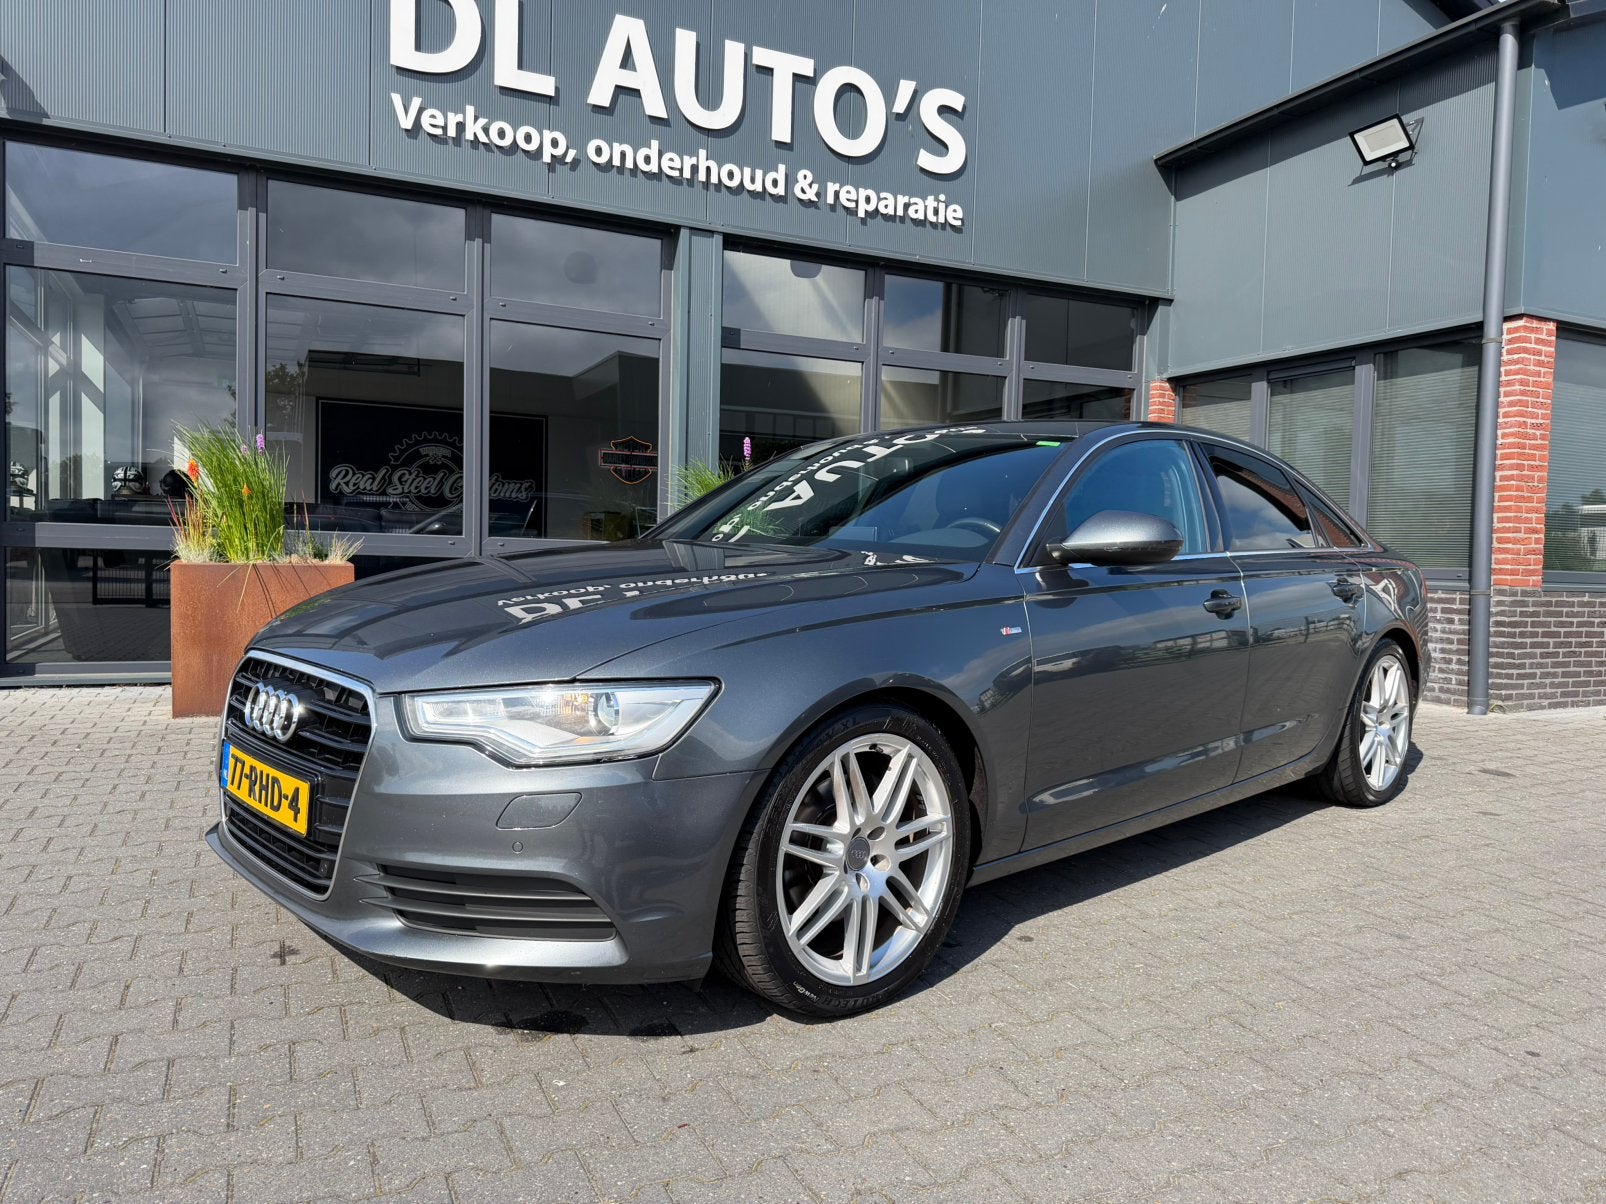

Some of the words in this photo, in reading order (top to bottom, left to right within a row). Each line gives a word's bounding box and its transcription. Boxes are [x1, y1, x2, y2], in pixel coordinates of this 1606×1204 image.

[390, 0, 556, 97] DL
[586, 13, 967, 175] AUTO'S
[390, 92, 577, 163] Verkoop,
[586, 135, 787, 198] onderhoud
[794, 168, 819, 202] &
[826, 181, 964, 227] reparatie
[330, 465, 390, 494] Real
[388, 468, 448, 496] Steel
[446, 473, 534, 501] Ctoms
[230, 753, 301, 823] 77-RHD-4
